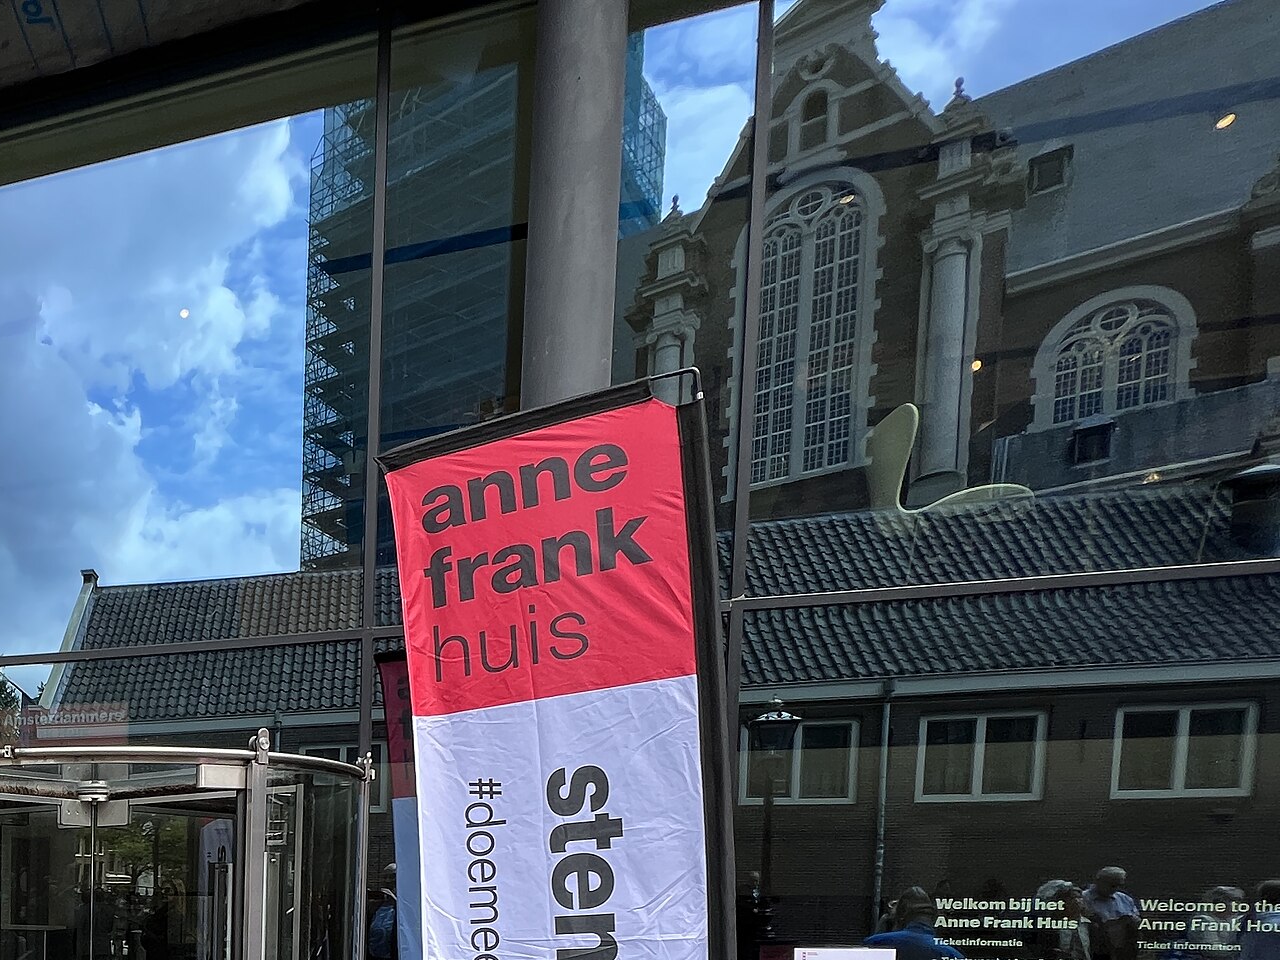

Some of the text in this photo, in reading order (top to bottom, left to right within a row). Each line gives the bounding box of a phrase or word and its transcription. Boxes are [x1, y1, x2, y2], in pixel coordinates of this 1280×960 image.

[421, 443, 628, 534] anne
[424, 507, 653, 609] frank
[433, 605, 589, 682] huis
[935, 898, 1065, 912] Welkom bij het
[1140, 899, 1226, 912] Welcome
[1231, 901, 1250, 912] to
[934, 916, 1078, 929] Anne Frank Huis
[1138, 918, 1280, 932] Anne Frank Hou
[1137, 941, 1241, 951] Ticket information
